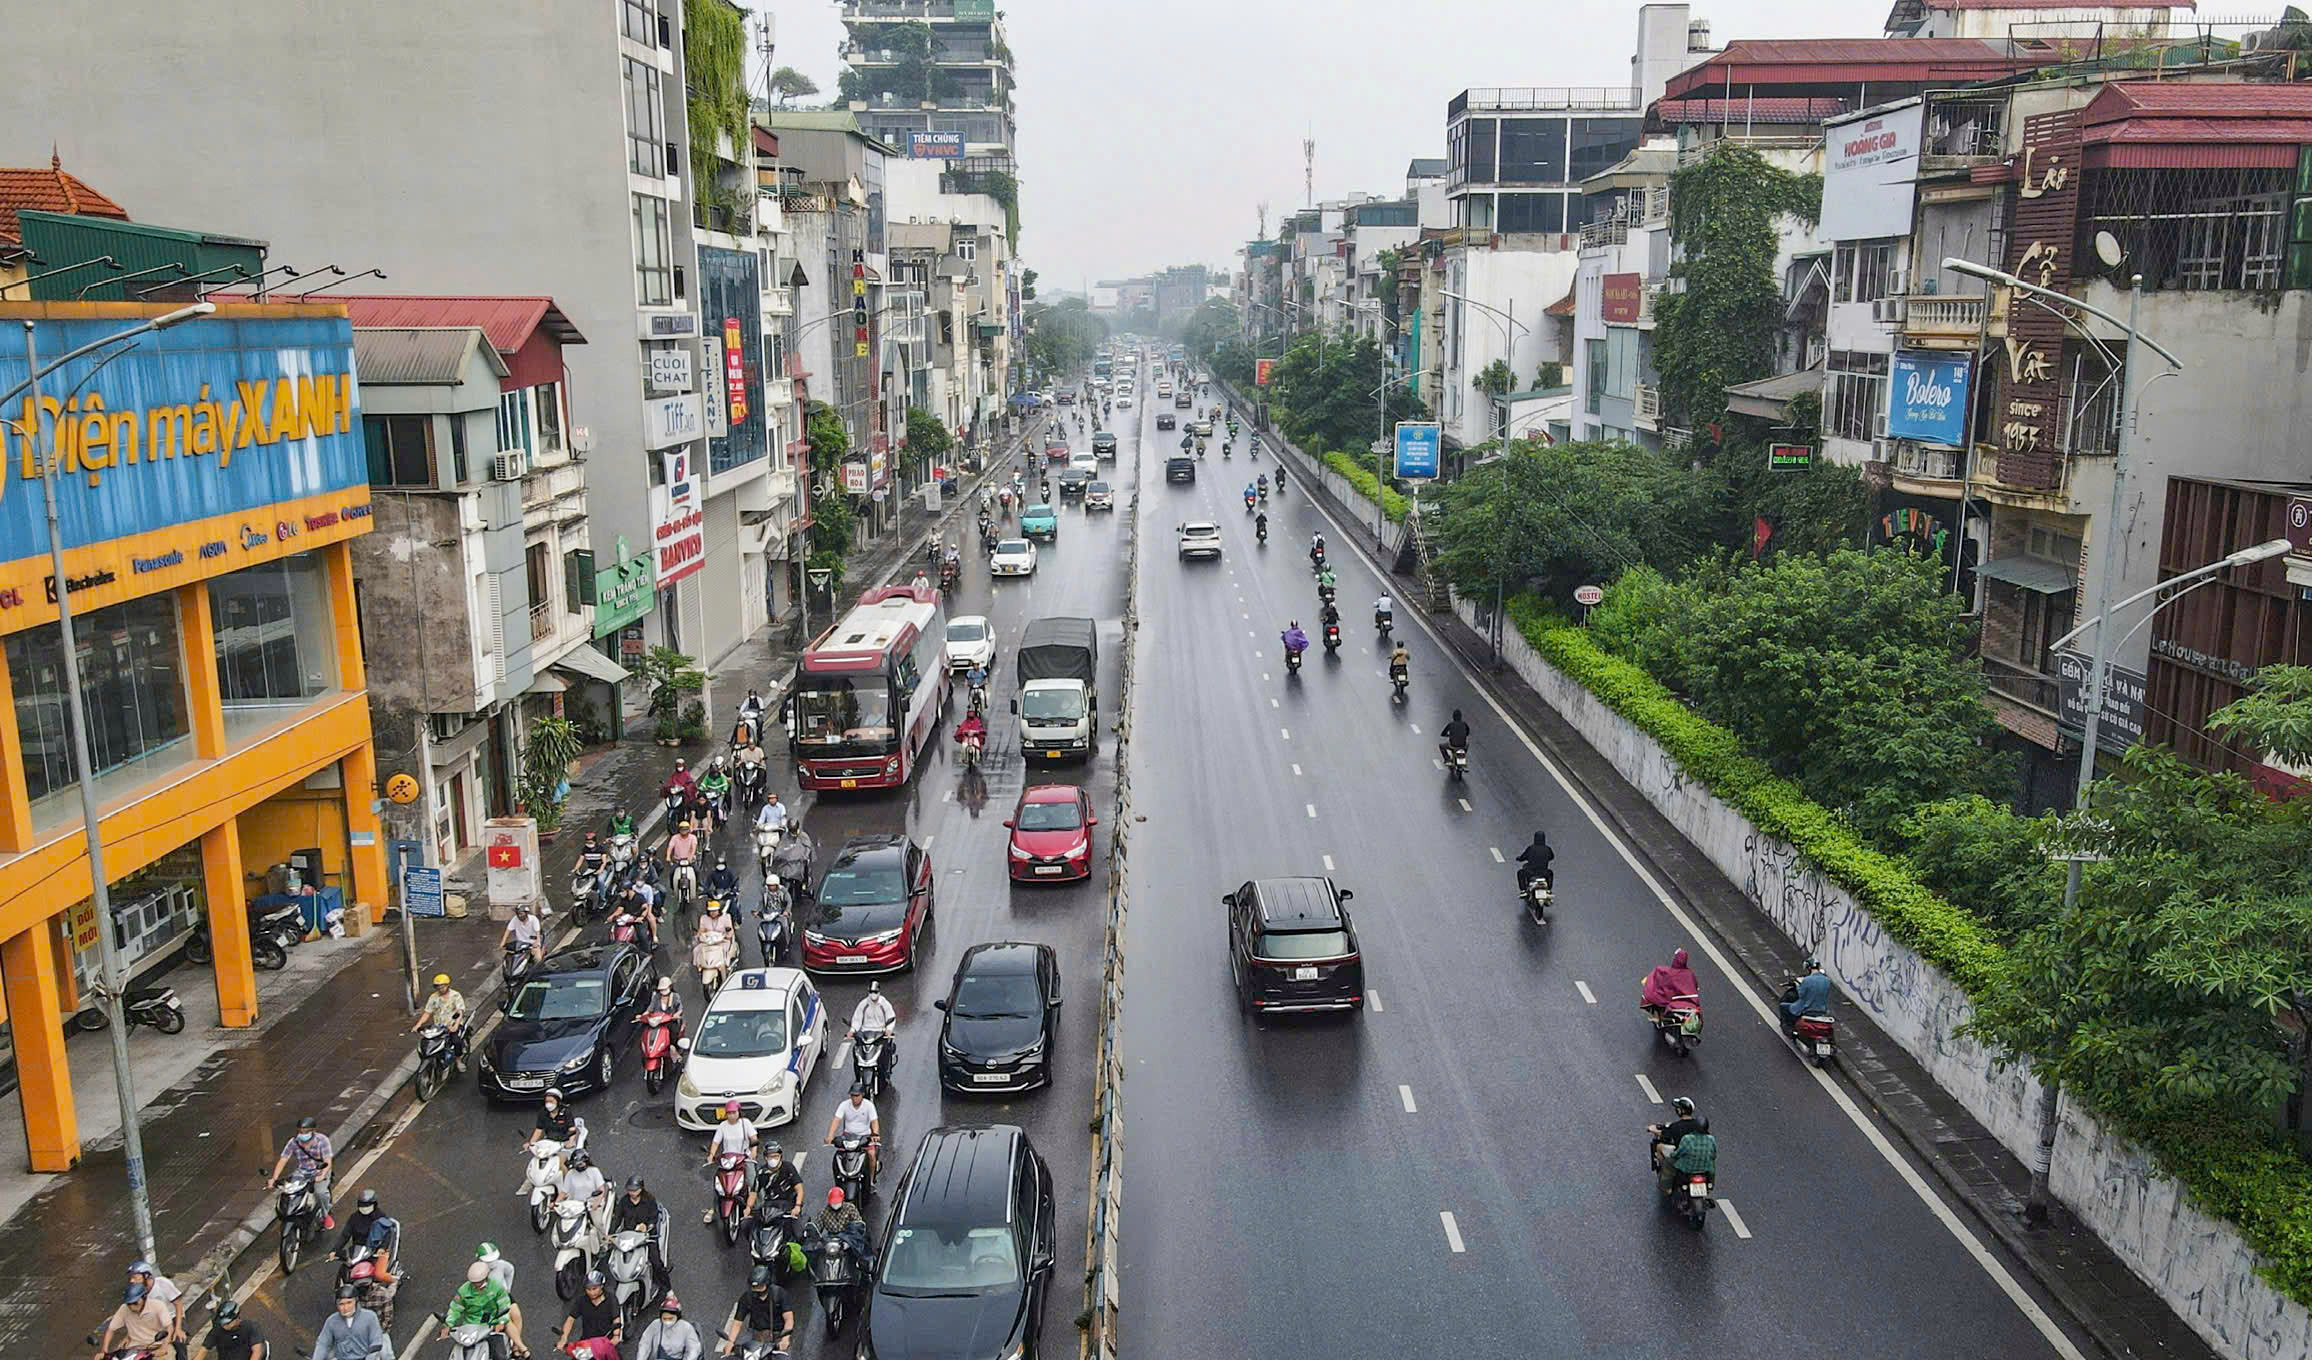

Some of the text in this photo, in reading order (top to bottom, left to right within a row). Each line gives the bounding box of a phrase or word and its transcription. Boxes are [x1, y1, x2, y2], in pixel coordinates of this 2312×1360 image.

[852, 248, 869, 357] KARAOKE
[653, 358, 686, 369] CUOI
[654, 372, 688, 383] CHAT
[703, 344, 716, 430] TIFFANY
[1906, 368, 1952, 408] Bolero
[2010, 399, 2042, 417] since
[2004, 422, 2040, 453] 1955
[132, 549, 184, 574] Panasonic
